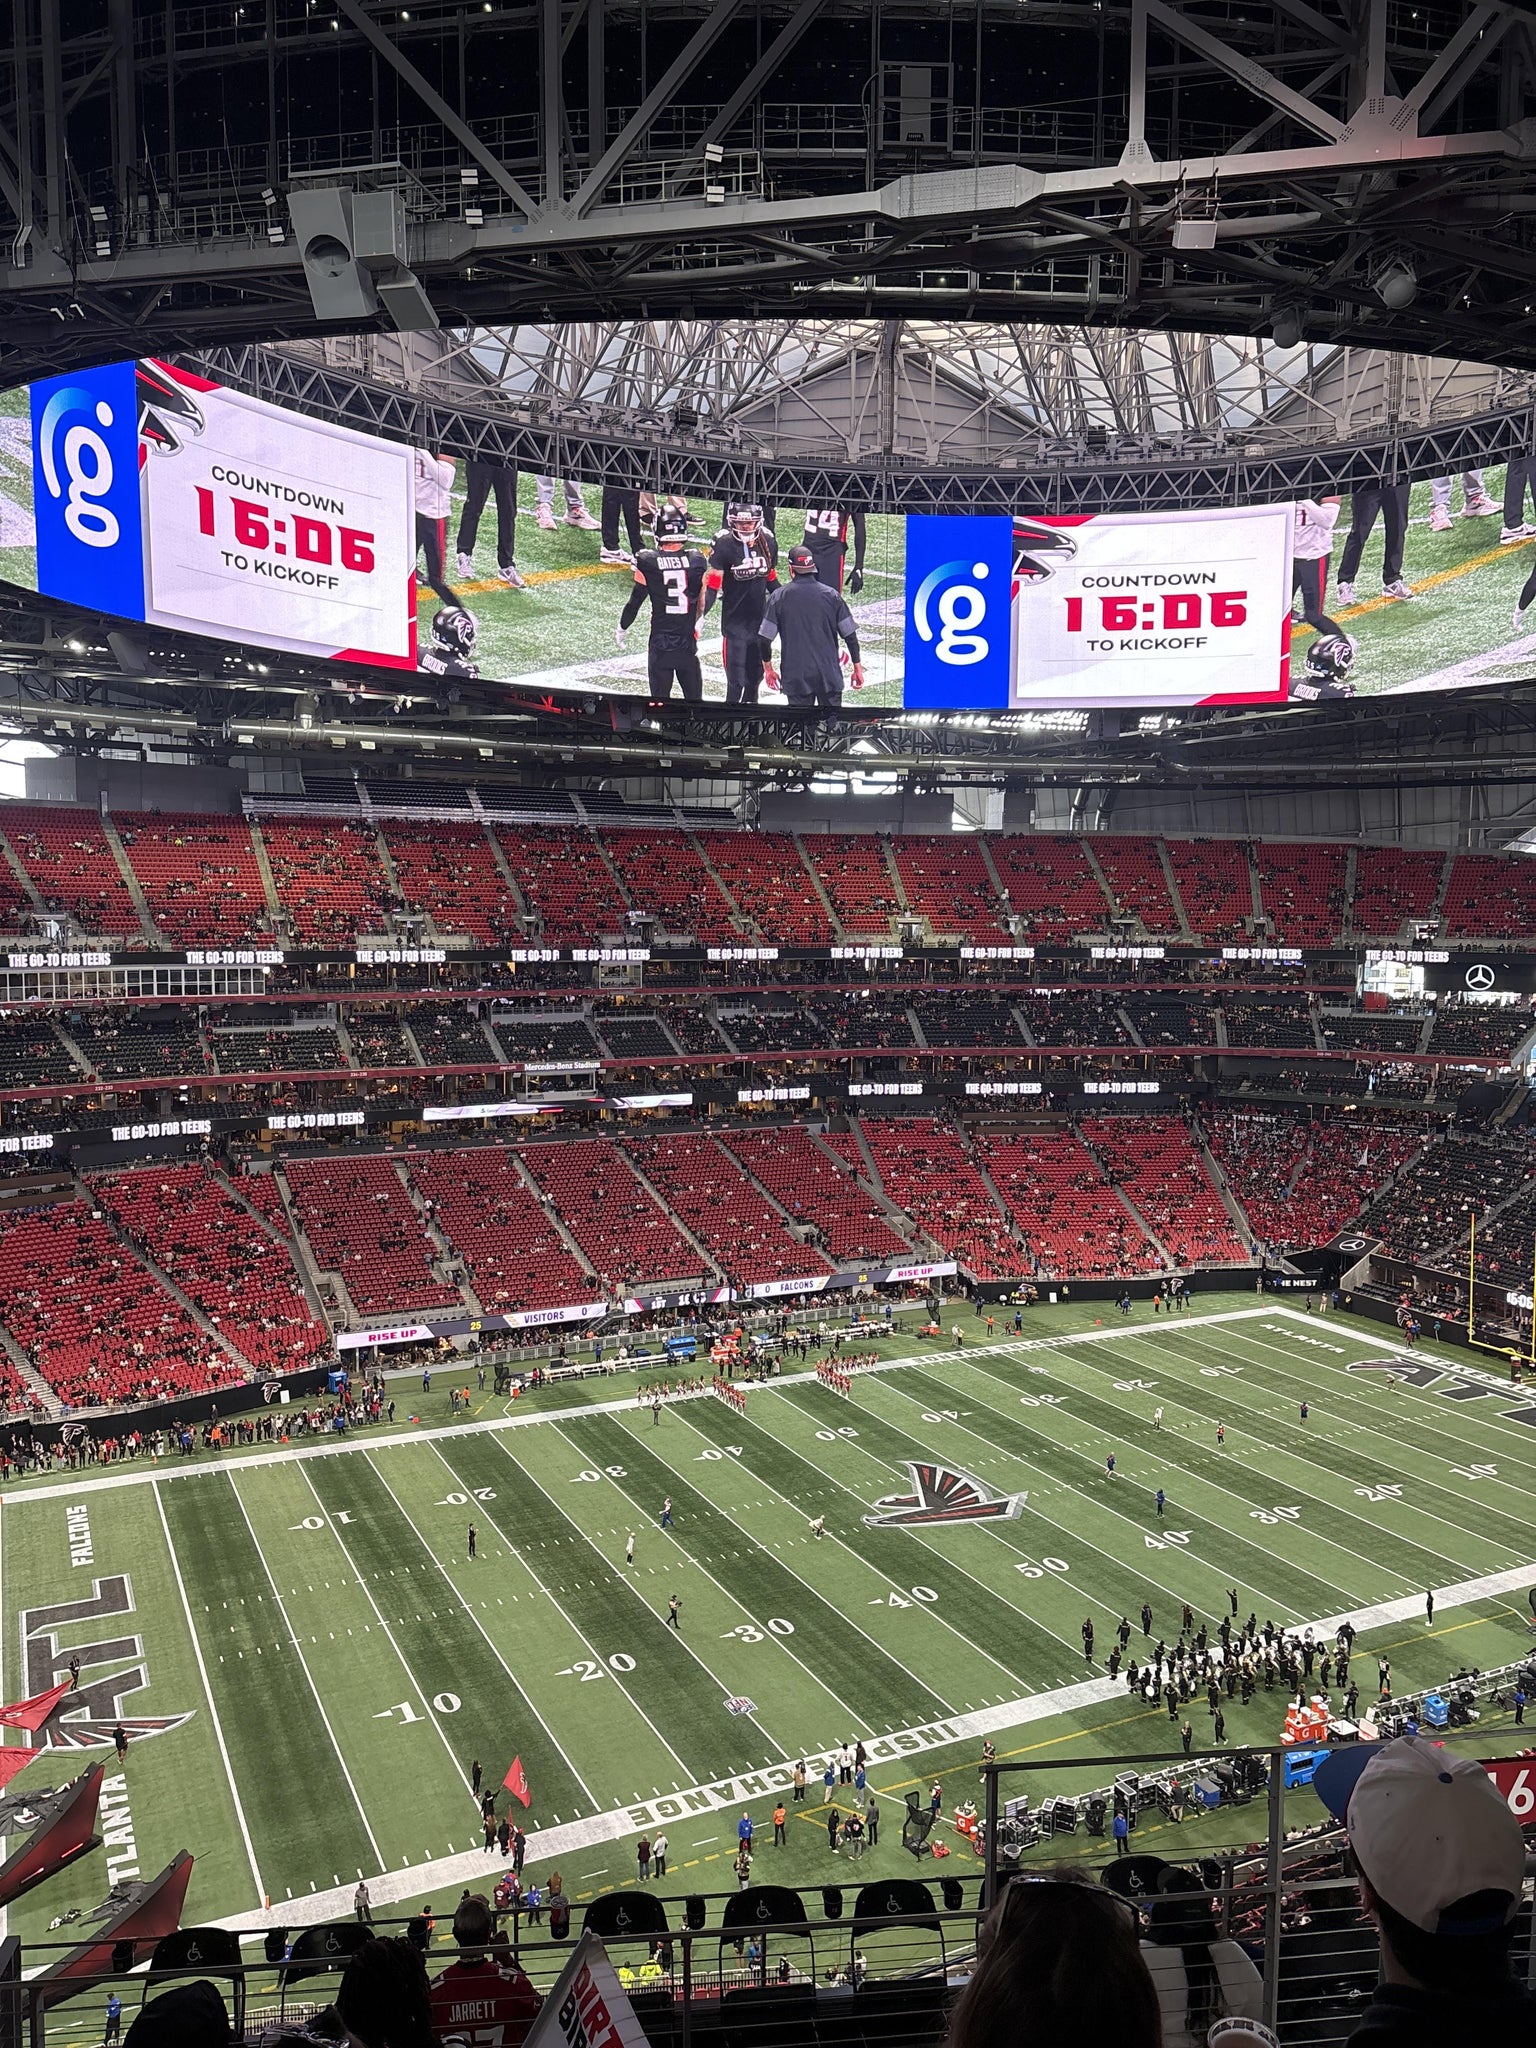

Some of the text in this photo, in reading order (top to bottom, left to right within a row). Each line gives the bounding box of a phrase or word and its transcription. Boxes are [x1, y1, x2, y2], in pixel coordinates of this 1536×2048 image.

[211, 465, 344, 515] COUNTDOWN
[193, 485, 374, 573] 16:06
[804, 510, 839, 537] 24
[221, 551, 339, 589] TO KICKOFF
[1081, 572, 1217, 588] COUNTDOWN
[664, 570, 688, 614] 3
[1063, 591, 1248, 632] 16:06
[1087, 637, 1207, 651] TO KICKOFF
[8, 952, 112, 968] THE GO-TO FOR TEENS
[186, 951, 284, 965] THE GO-TO FOR TEENS
[356, 950, 446, 963] THE GO-TO FOR TEENS
[511, 950, 527, 962] THE
[528, 950, 551, 962] GO-TO
[572, 949, 650, 962] THE GO-TO FOR TEENS
[707, 948, 779, 960] THE GO-TO FOR TEENS
[831, 947, 903, 959] THE GO-TO FOR TEENS
[960, 947, 1034, 959] THE GO-TO FOR TEENS
[1090, 947, 1165, 959] THE GO-TO FOR TEENS
[1222, 948, 1302, 960] THE GO-TO FOR TEENS
[1366, 950, 1449, 963] THE GO-TO FOR TEENS
[525, 1063, 573, 1071] Mercedes-Benz
[738, 1087, 809, 1102] THE GO-TO FOR TEENS
[848, 1084, 922, 1095] THE GO-TO FOR TEENS
[965, 1083, 1041, 1094] THE GO-TO FOR TEENS
[1083, 1082, 1159, 1093] THE GO-TO FOR TEENS
[268, 1112, 364, 1130] THE GO-TO FOR TEENS
[112, 1120, 211, 1141] THE GO-TO FOR TEENS
[21, 1134, 53, 1150] TEENS
[897, 1267, 934, 1278] RISE UP
[765, 1280, 814, 1293] 0 FALCONS
[524, 1307, 588, 1324] VISITORS 0
[470, 1321, 482, 1331] 25
[368, 1329, 417, 1343] RISE UP
[1259, 1323, 1346, 1355] ATLANTA
[1112, 1378, 1154, 1393] 20
[1019, 1393, 1063, 1409] 30
[920, 1409, 960, 1424] 40
[815, 1425, 860, 1442] 50
[701, 1445, 744, 1462] 40
[579, 1465, 628, 1483] 30
[1449, 1463, 1497, 1481] 10
[446, 1487, 498, 1508] 20
[1353, 1484, 1402, 1502] 20
[302, 1510, 358, 1532] 10
[1249, 1505, 1301, 1525] 30
[66, 1505, 94, 1568] FALCONS
[1144, 1529, 1190, 1551] 40
[1014, 1556, 1070, 1579] 50
[883, 1585, 939, 1610] 40
[734, 1616, 795, 1643] 30
[573, 1652, 637, 1682] 20
[391, 1692, 463, 1725] 10
[628, 1768, 795, 1827] CHANGE
[102, 1773, 141, 1888] TLANTA
[957, 1818, 966, 1829] G
[449, 2000, 496, 2023] JARRETT
